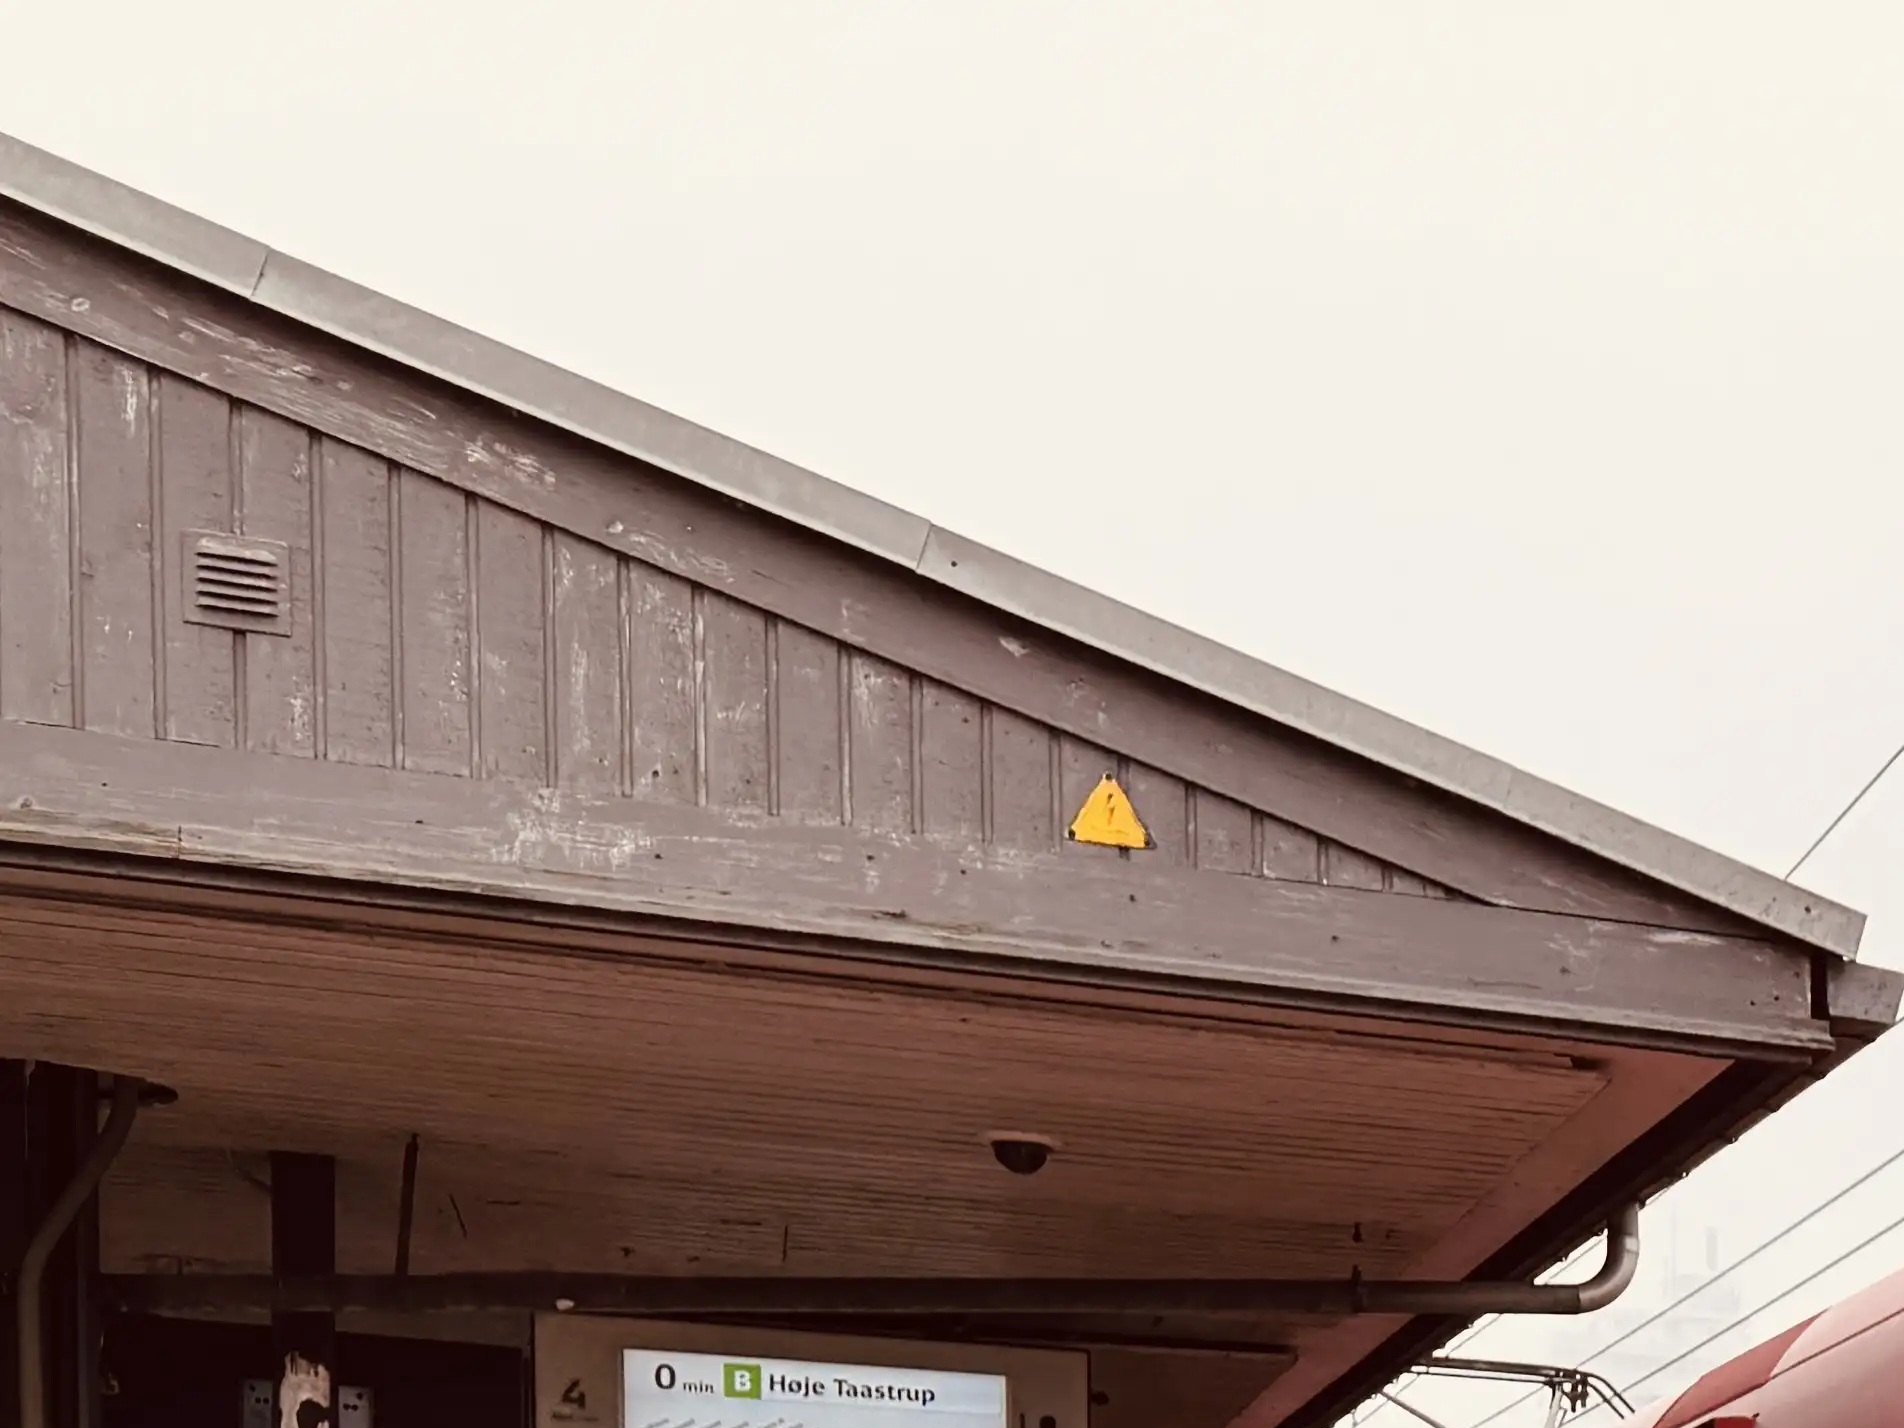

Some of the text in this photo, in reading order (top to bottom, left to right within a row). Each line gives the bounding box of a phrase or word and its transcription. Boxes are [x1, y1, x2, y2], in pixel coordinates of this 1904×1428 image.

[655, 1364, 936, 1406] 0 min B Høje Taastrup
